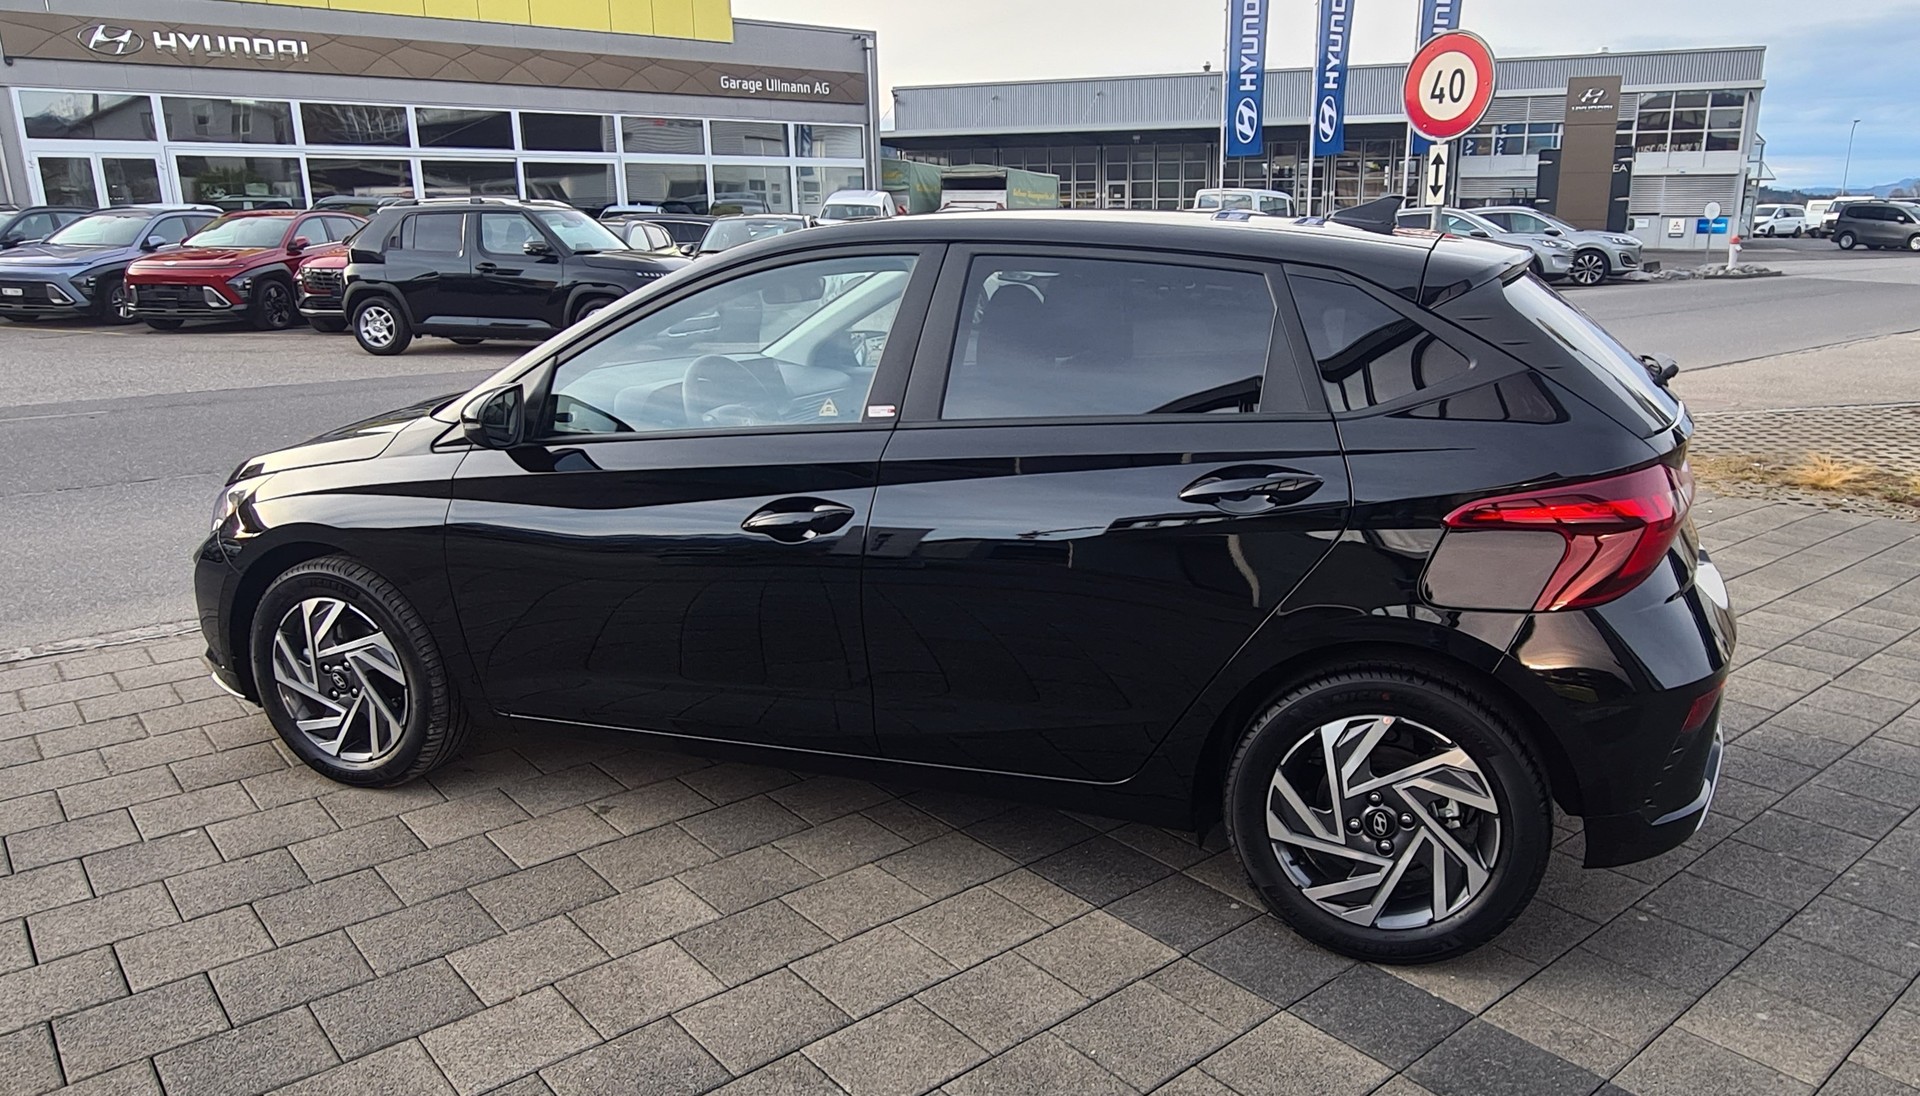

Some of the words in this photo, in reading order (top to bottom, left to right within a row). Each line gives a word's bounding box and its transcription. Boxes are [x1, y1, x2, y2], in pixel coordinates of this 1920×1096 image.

[152, 31, 310, 63] HYUNDAI
[720, 75, 763, 93] Garage
[765, 78, 811, 94] Ullmann
[813, 81, 830, 95] AG
[1430, 68, 1466, 105] 40
